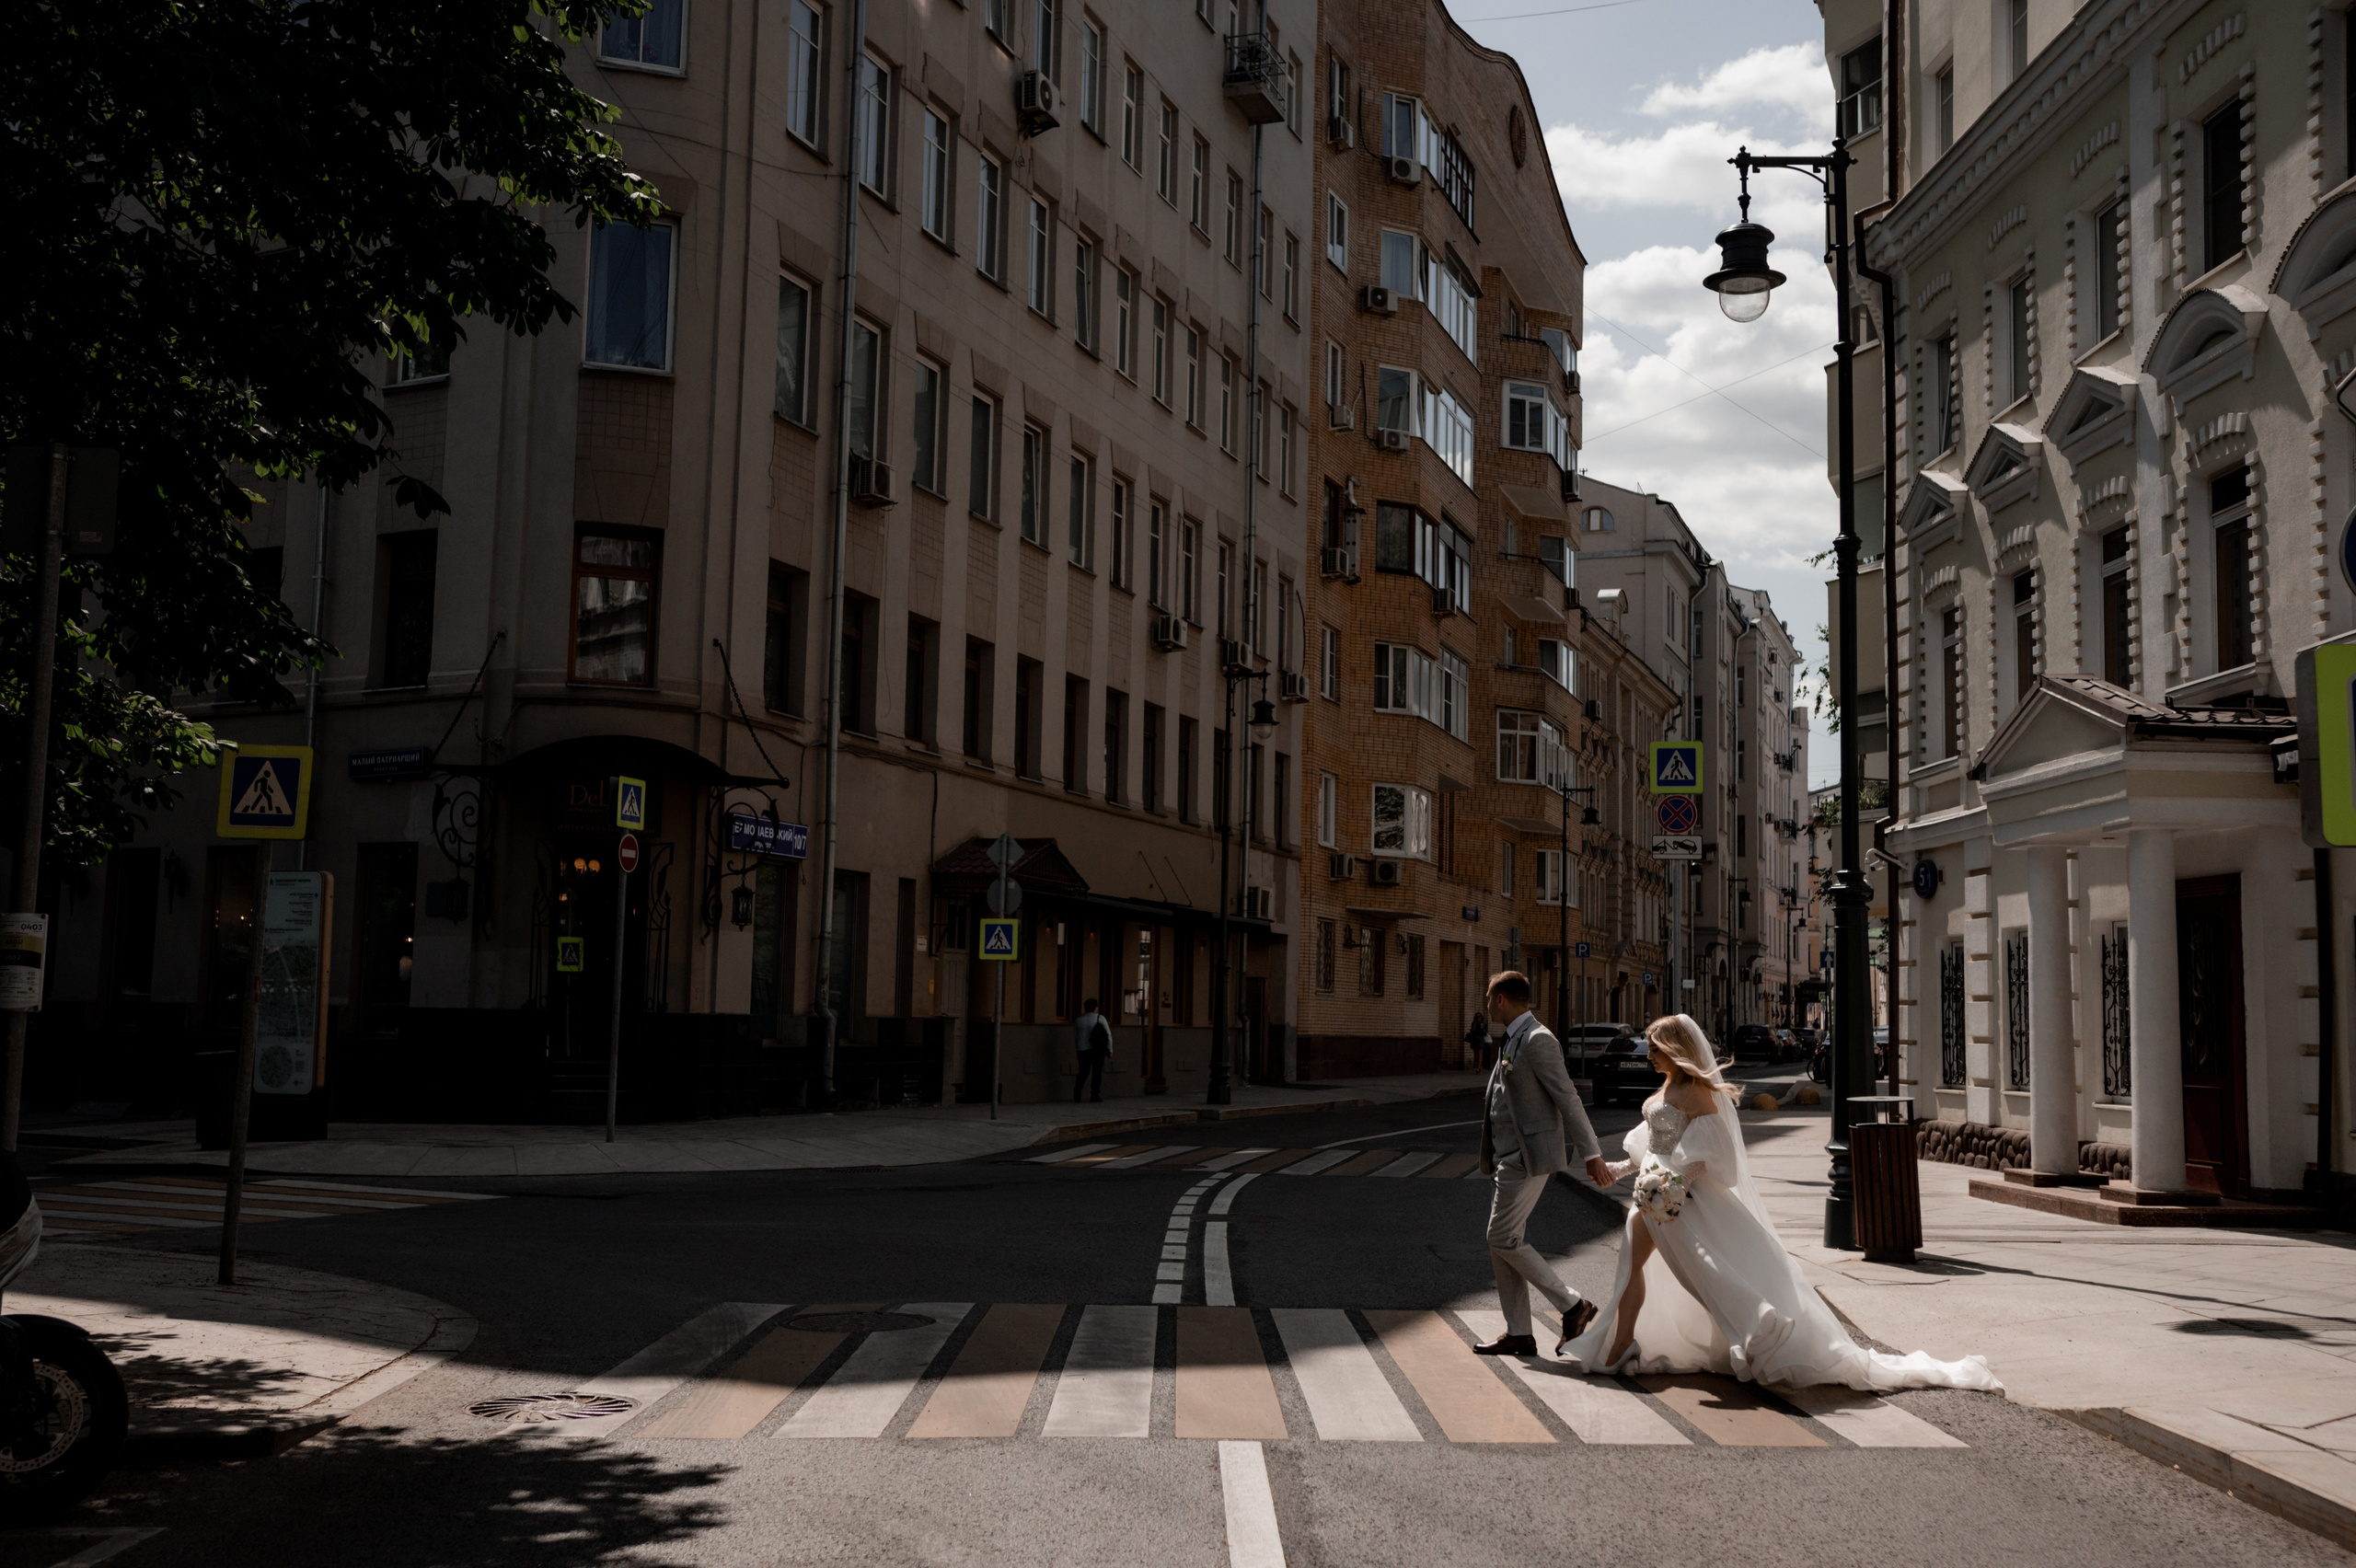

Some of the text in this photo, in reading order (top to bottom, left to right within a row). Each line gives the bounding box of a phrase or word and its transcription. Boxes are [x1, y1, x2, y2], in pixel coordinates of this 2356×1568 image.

[352, 752, 420, 766] МАЛЫЙ ПАТРИАРШИЙ
[734, 822, 807, 851] ЕМОАЕВКИЙ 10/7
[1919, 867, 1925, 887] 5
[1578, 944, 1588, 956] P
[1645, 974, 1652, 985] P
